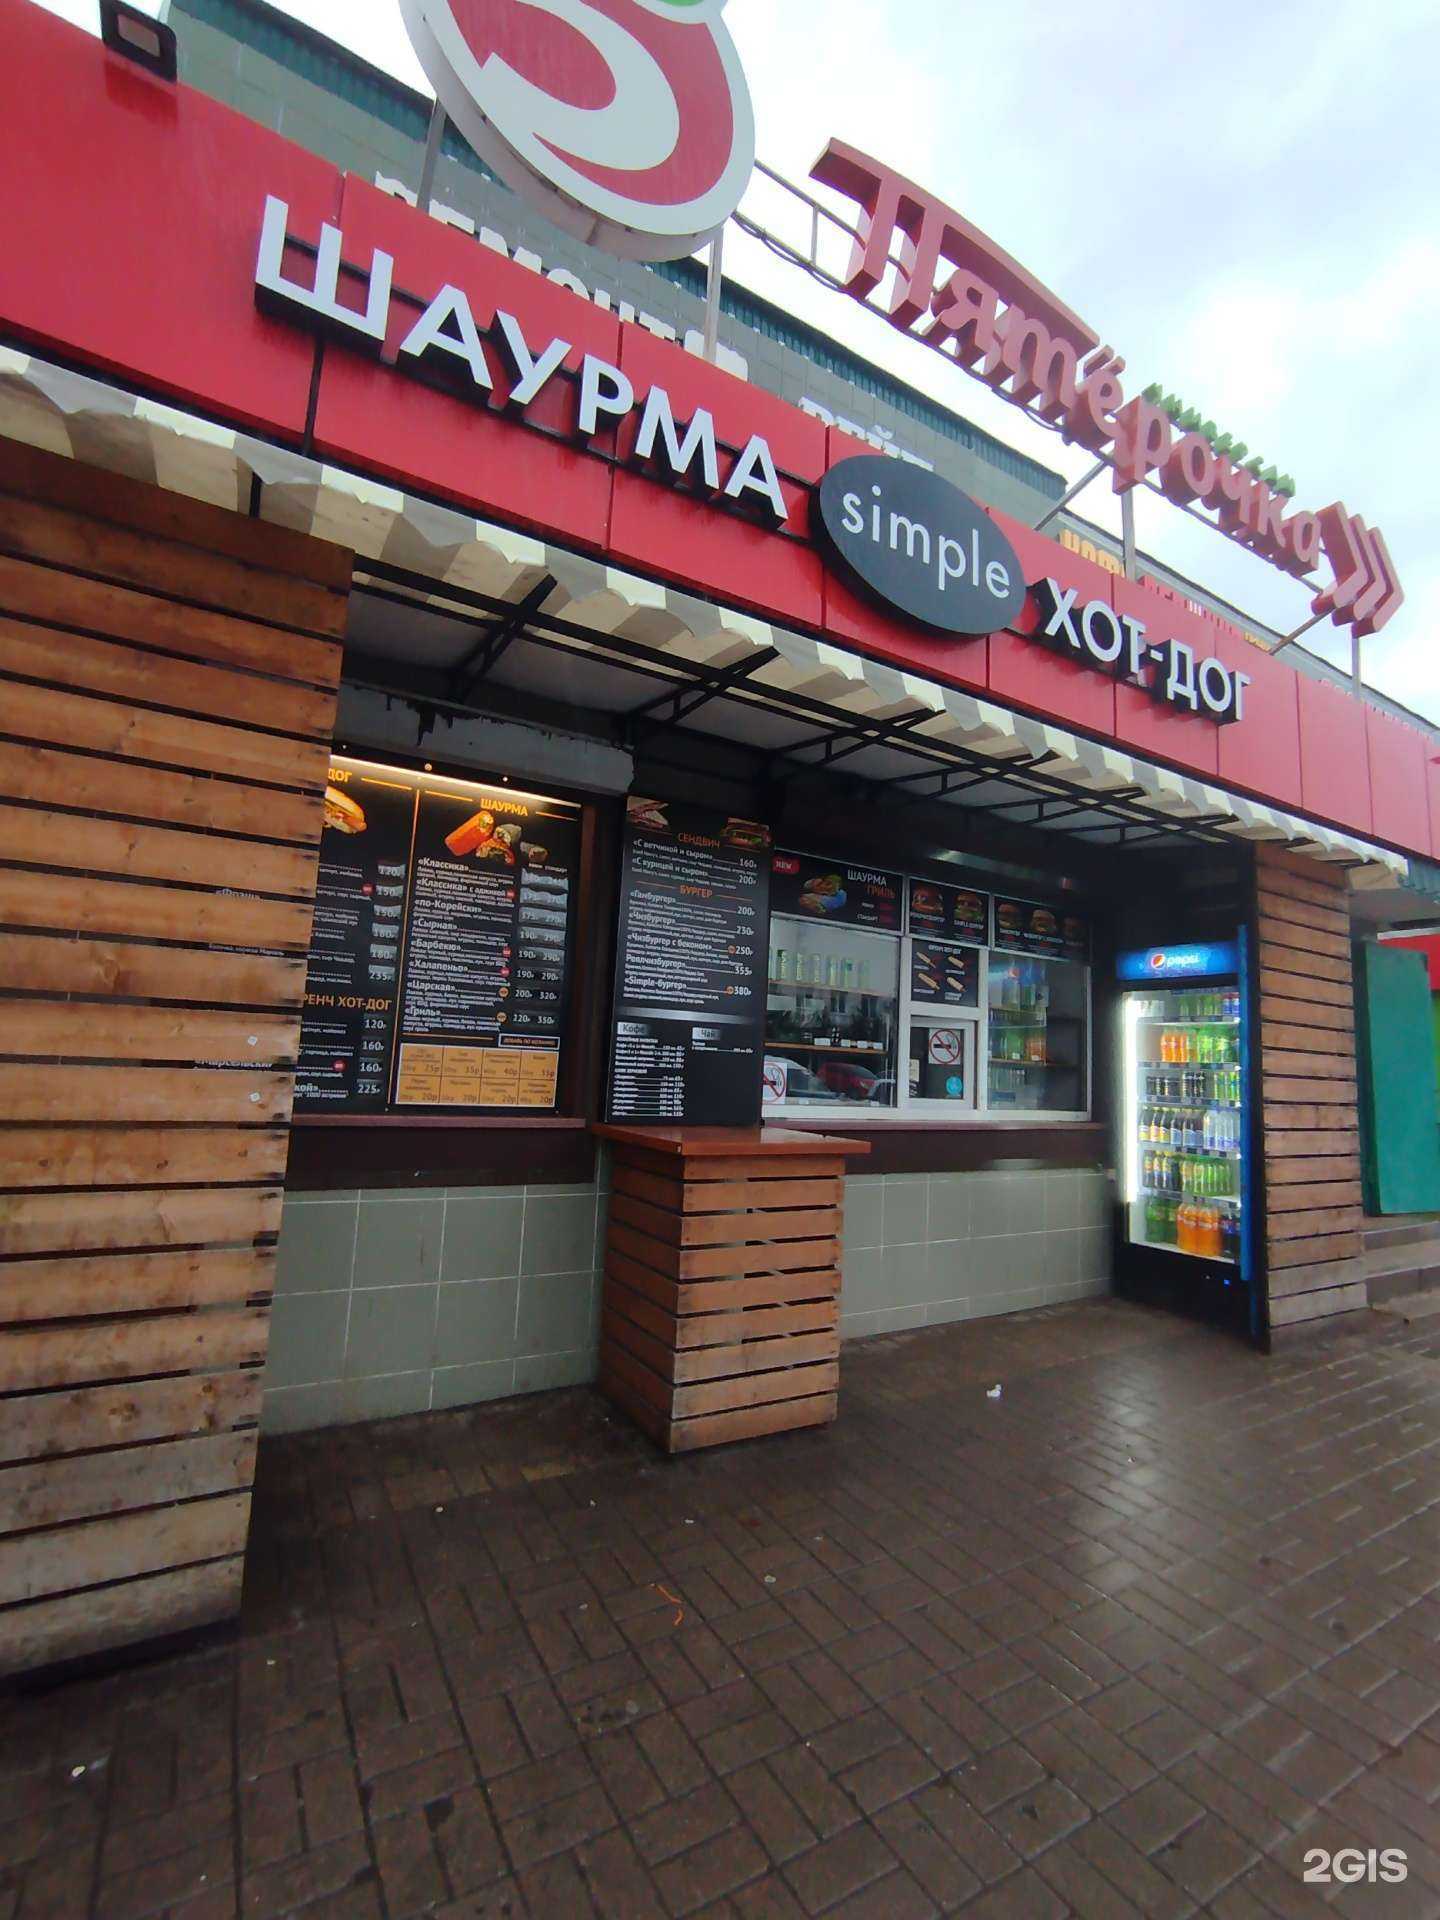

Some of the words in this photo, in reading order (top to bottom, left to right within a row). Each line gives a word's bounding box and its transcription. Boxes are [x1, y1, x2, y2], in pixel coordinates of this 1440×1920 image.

[256, 194, 787, 530] ШАУРМА
[841, 486, 1011, 600] simple
[1043, 578, 1253, 721] ХОТ-ДОГ
[480, 798, 528, 816] ШАУРМА
[848, 869, 887, 887] ШАУРМА
[680, 884, 713, 898] БУРГЕР
[338, 996, 392, 1011] ХОТ-ДОГ
[623, 1024, 647, 1034] Кофе
